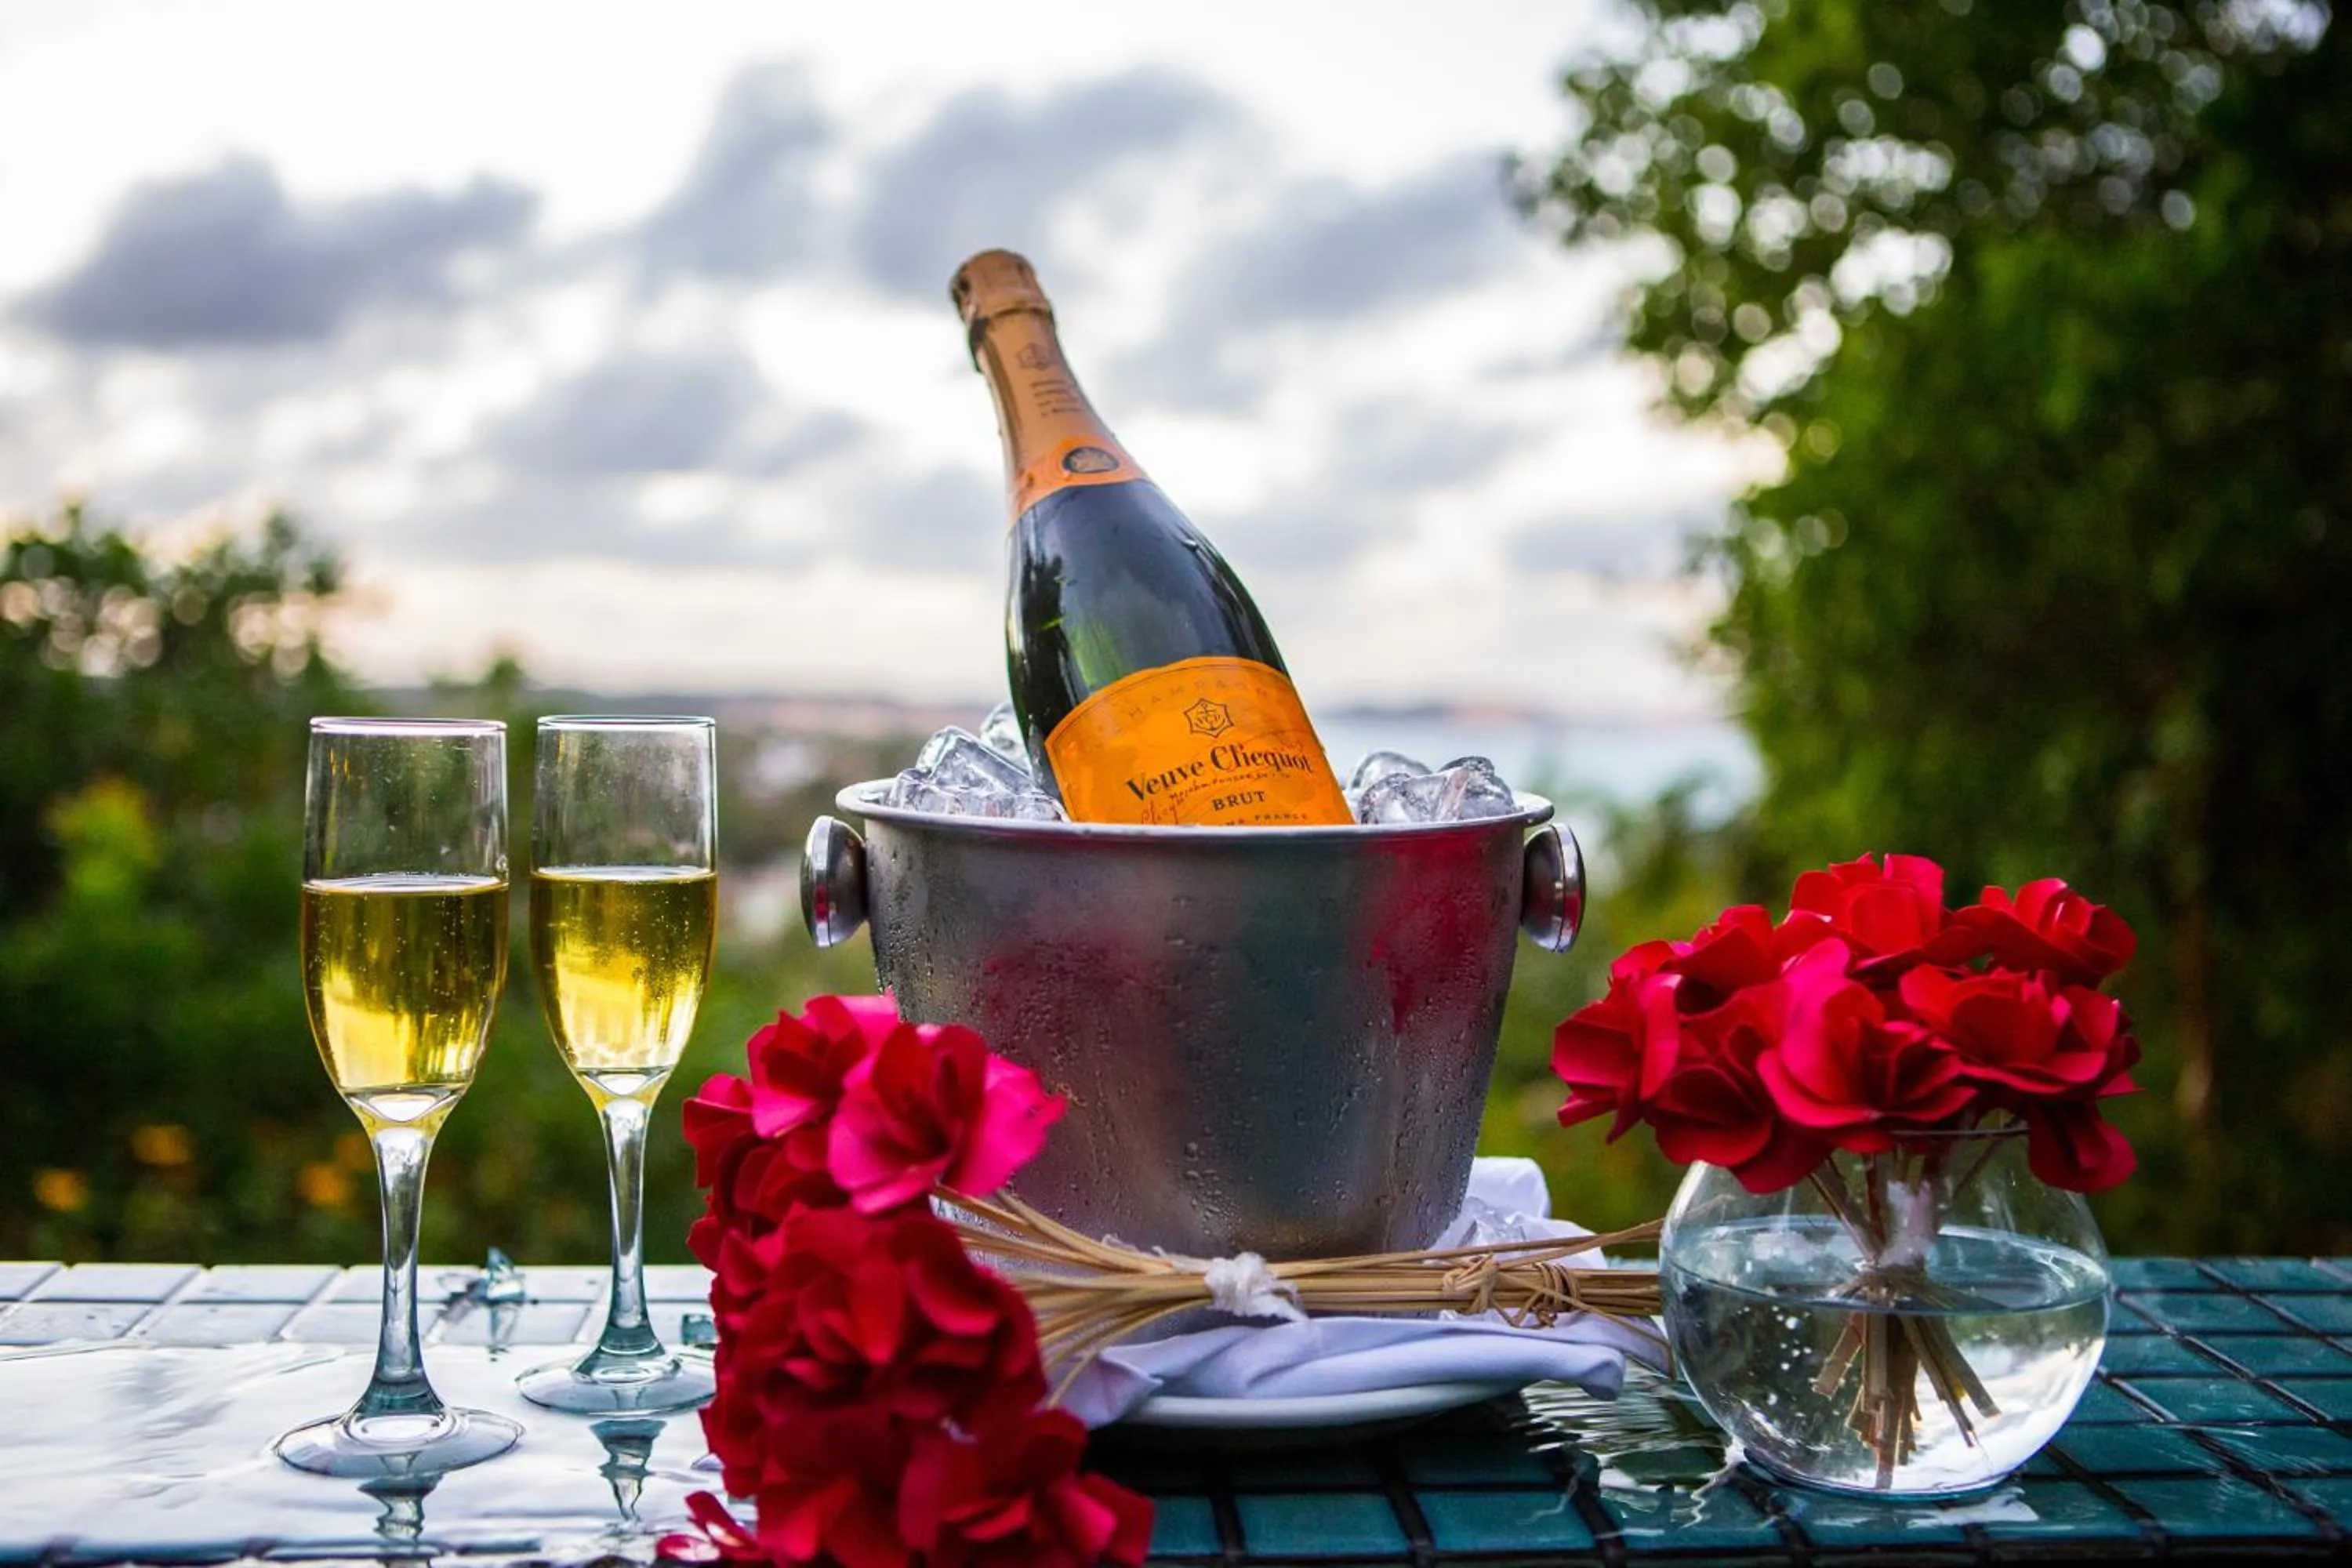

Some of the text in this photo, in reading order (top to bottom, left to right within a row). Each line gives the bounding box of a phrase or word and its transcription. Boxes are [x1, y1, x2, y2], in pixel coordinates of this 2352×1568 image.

[1126, 759, 1204, 800] Veuve
[1210, 743, 1314, 775] Clicquot
[1211, 790, 1265, 811] BRUT
